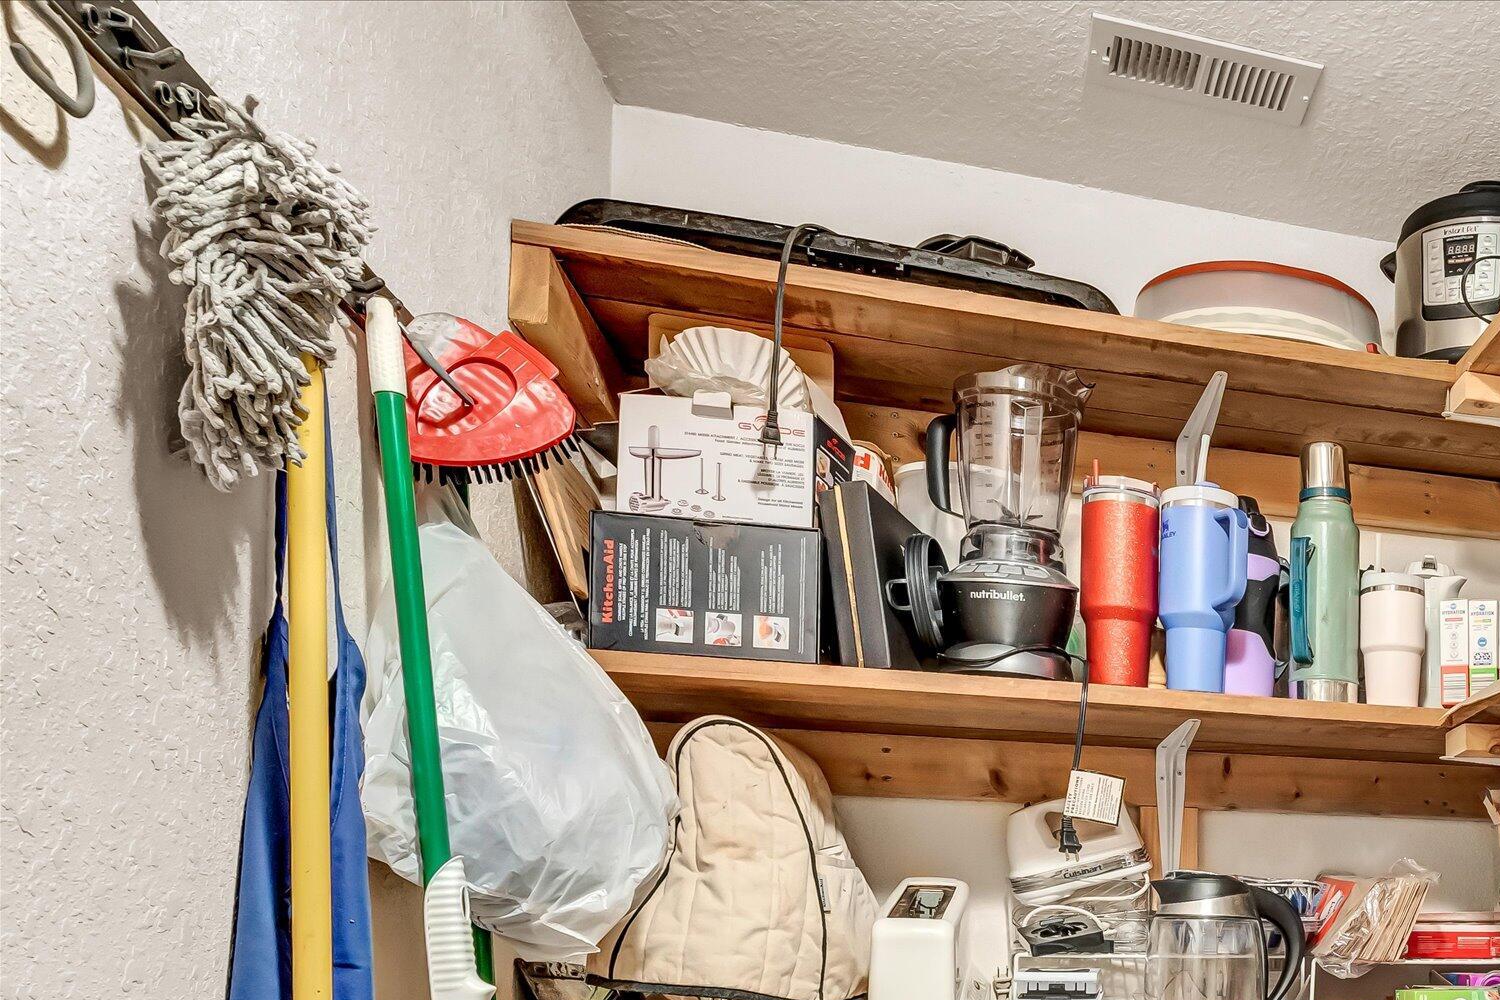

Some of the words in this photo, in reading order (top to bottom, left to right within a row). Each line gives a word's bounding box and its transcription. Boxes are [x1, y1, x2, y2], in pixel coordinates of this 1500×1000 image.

[602, 540, 615, 622] KitchenAid
[970, 589, 1026, 602] nutribullet.
[1063, 865, 1103, 879] Cuisinart
